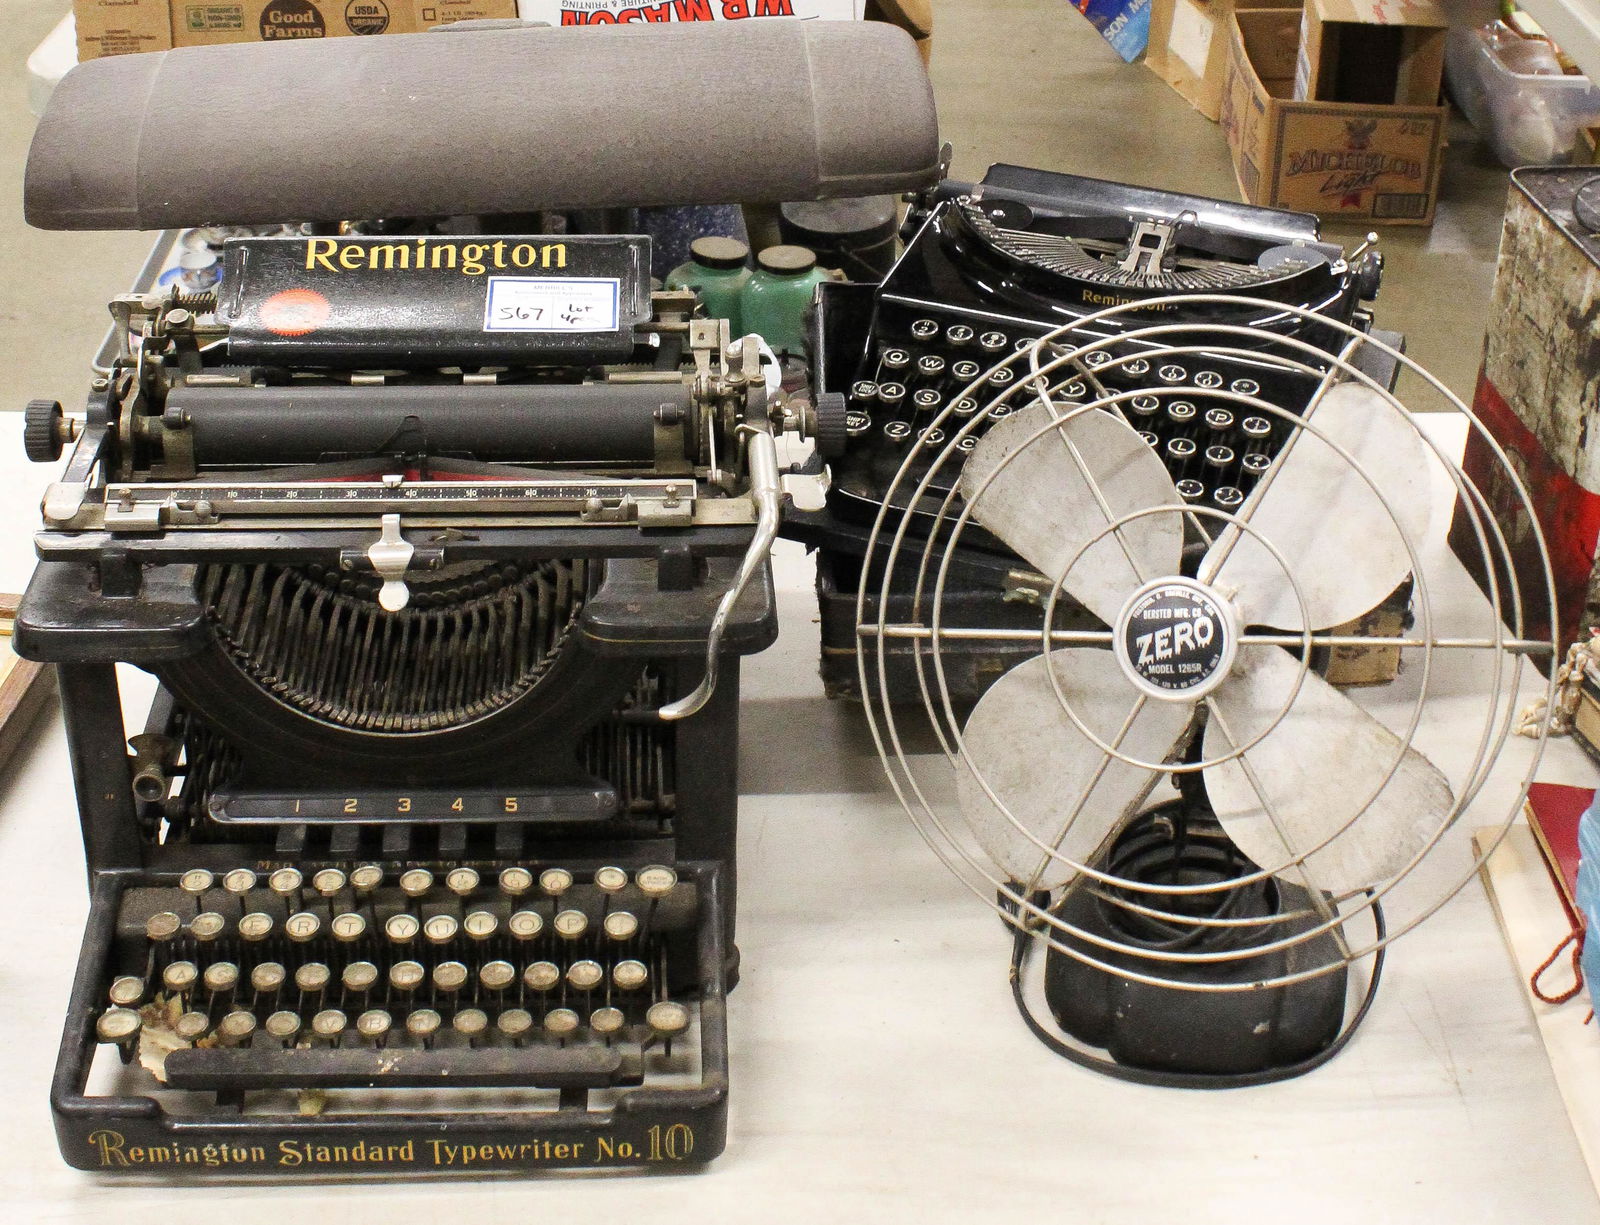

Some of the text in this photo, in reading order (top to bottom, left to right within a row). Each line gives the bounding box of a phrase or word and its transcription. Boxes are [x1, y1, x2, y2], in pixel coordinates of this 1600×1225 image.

[561, 0, 608, 9] PRINTING
[354, 6, 379, 15] USDA
[269, 10, 314, 23] Good
[352, 18, 384, 26] ORGANIC
[263, 24, 323, 38] Farms
[305, 238, 567, 276] Remington
[498, 306, 544, 320] 567
[889, 352, 904, 362] Q
[924, 359, 940, 368] W
[960, 364, 972, 374] E
[993, 371, 1007, 380] R
[885, 385, 897, 395] A
[1069, 384, 1080, 394] Y
[919, 392, 934, 402] S
[958, 399, 970, 409] D
[994, 406, 1007, 415] F
[1178, 405, 1189, 414] O
[1214, 413, 1228, 422] P
[891, 424, 905, 434] Z
[961, 439, 975, 448] C
[1177, 441, 1187, 452] L
[286, 491, 298, 499] 20
[345, 490, 357, 498] 30
[405, 489, 417, 497] 40
[465, 489, 477, 497] 50
[525, 489, 537, 497] 60
[1135, 615, 1214, 667] ZERO
[1148, 663, 1175, 674] MODEL
[296, 797, 518, 812] 1 2 3 4 5
[297, 921, 311, 932] R
[344, 922, 356, 933] T
[397, 923, 409, 935] Y
[435, 924, 449, 934] U
[519, 919, 534, 931] O
[566, 918, 580, 930] P
[88, 1123, 694, 1167] Remington Standard Typewriter No. 10
